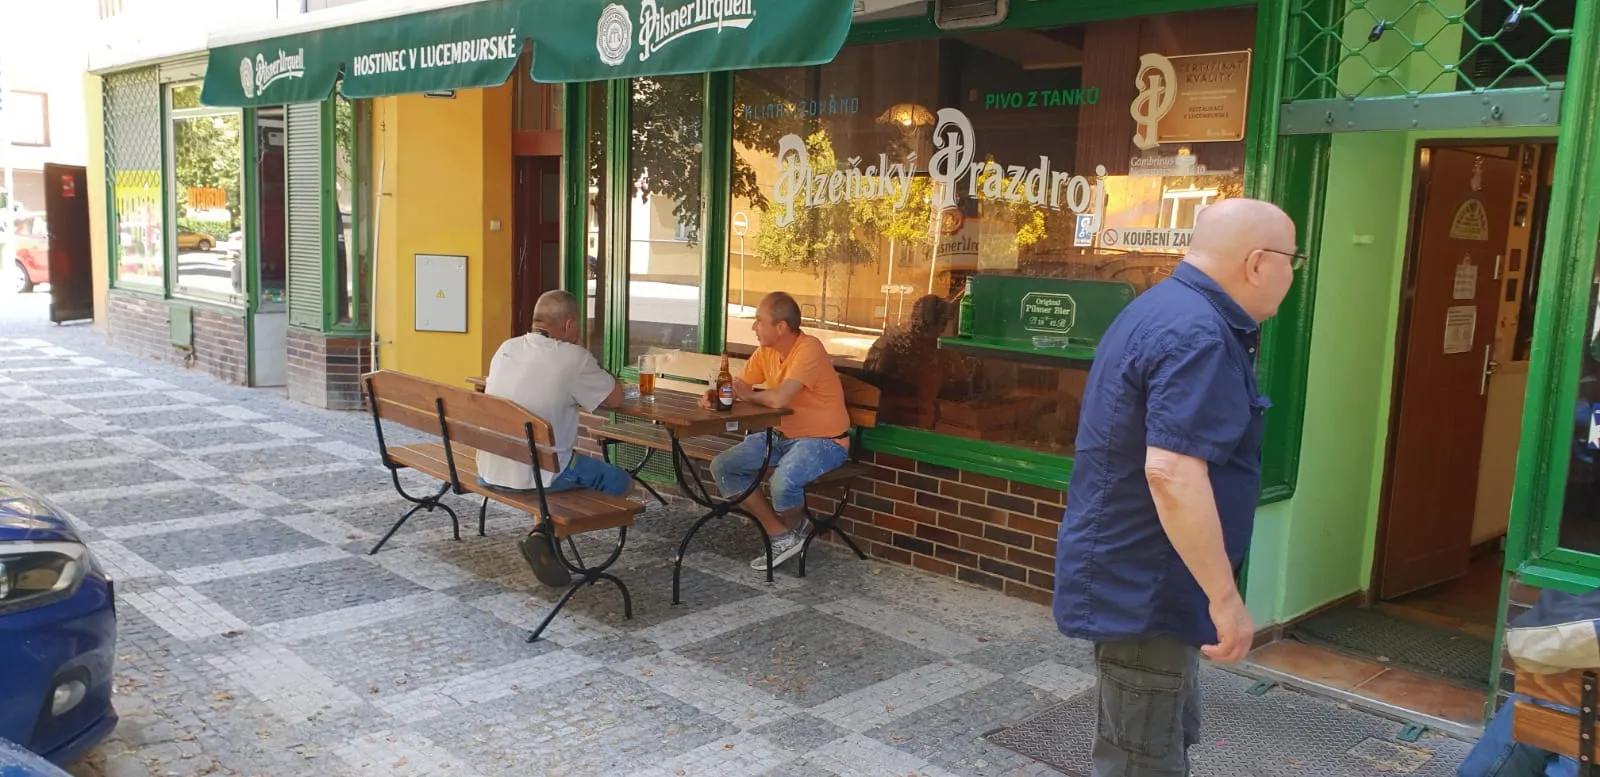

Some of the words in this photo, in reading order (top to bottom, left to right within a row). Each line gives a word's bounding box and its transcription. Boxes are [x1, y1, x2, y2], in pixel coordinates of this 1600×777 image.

[638, 0, 695, 61] Pilsner
[353, 49, 407, 77] HOSTINEC
[409, 48, 418, 70] V
[420, 28, 517, 69] LUCEMBURSKÉ
[256, 53, 280, 96] Pilsner
[985, 92, 1023, 111] PIVO
[1026, 90, 1039, 107] Z
[772, 133, 918, 228] Plzeňský
[928, 107, 1107, 234] Prazdroj
[1122, 228, 1171, 246] KOUŘENÍ
[1035, 298, 1061, 306] Original
